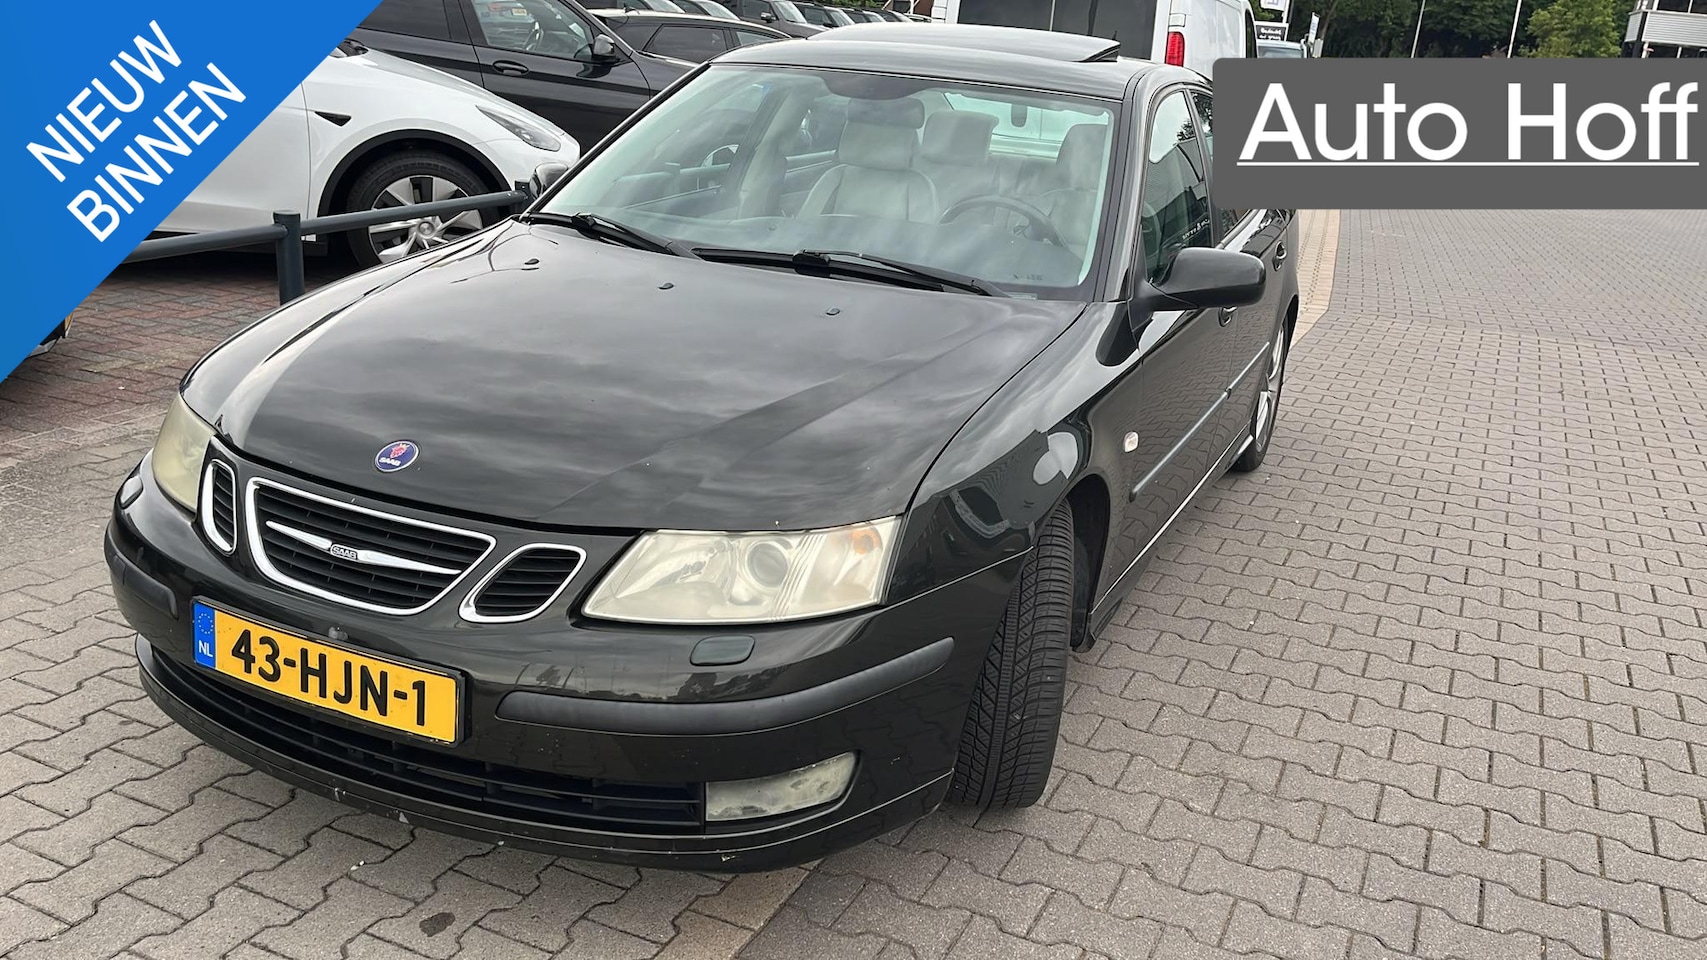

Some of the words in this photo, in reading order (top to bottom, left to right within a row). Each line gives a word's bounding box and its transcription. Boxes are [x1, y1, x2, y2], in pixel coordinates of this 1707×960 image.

[331, 545, 357, 560] SAAB
[198, 639, 213, 658] NL
[231, 629, 426, 727] 43-HJN-1
